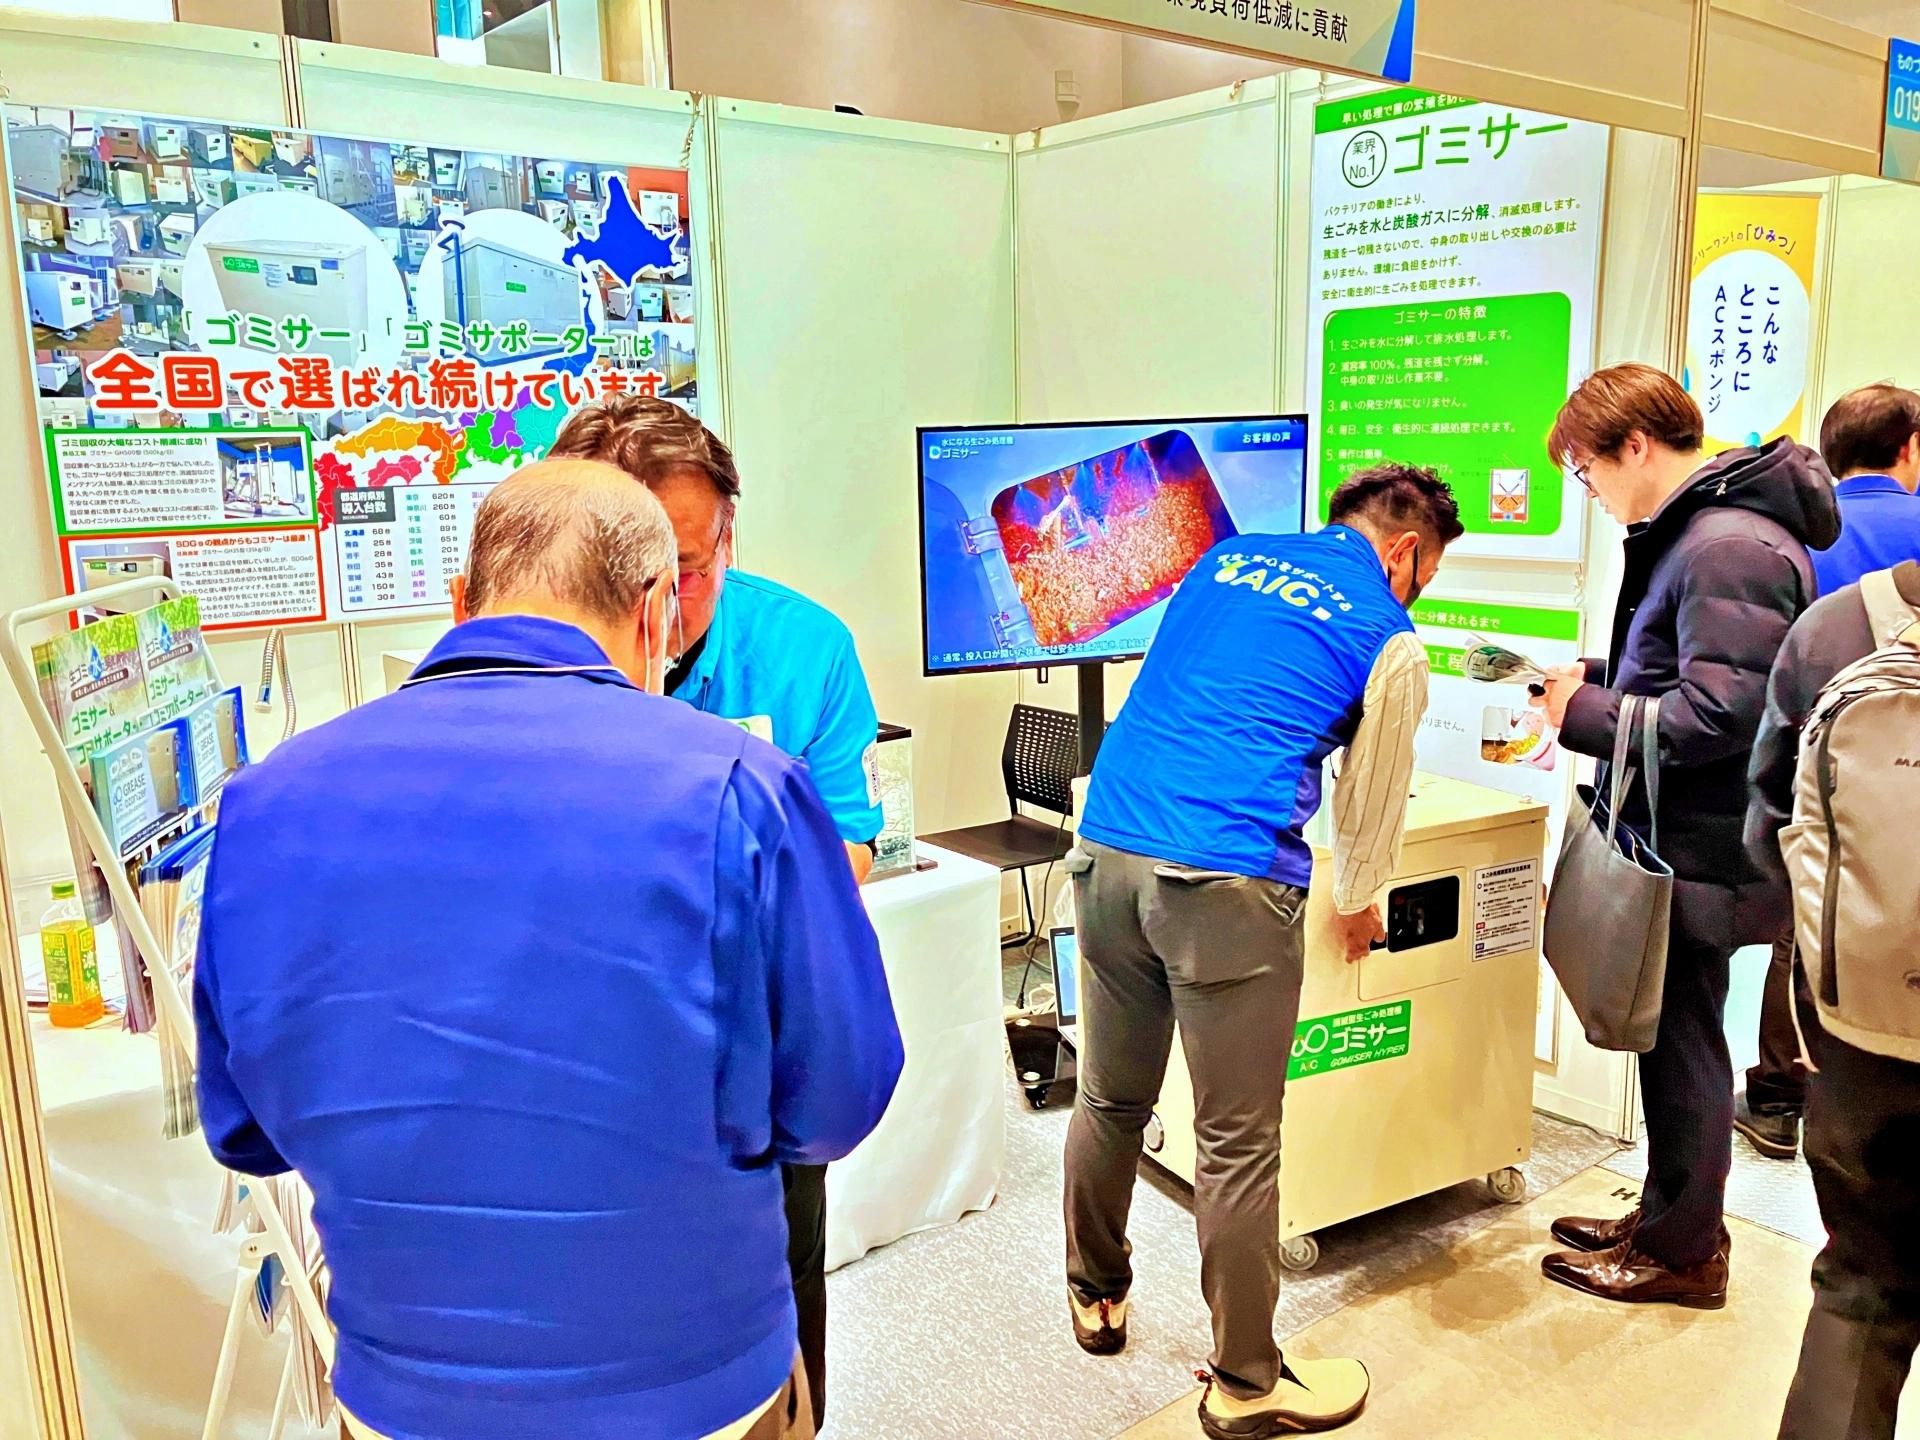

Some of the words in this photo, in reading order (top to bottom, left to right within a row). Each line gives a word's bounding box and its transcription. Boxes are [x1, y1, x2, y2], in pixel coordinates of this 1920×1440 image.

[1167, 0, 1348, 43] 負荷低減に貢献
[1894, 86, 1920, 123] 019
[1352, 138, 1376, 154] 業界
[1394, 113, 1568, 174] ゴミサー
[1350, 154, 1376, 179] No.1
[1323, 197, 1581, 239] 生ごみを水と炭酸ガスに分解、消滅処理します。
[1325, 194, 1426, 217] バクテリアの働きにより、
[1323, 255, 1462, 280] ありません。環境に負担をかけず、
[1393, 305, 1487, 325] ゴミサーの特徴
[1763, 286, 1780, 364] こんな
[1708, 285, 1727, 413] ACスポンジ
[1733, 284, 1755, 392] ところに
[1242, 431, 1291, 443] お客様の声
[942, 448, 979, 459] ゴミサー
[341, 501, 387, 514] 導入台数
[1230, 569, 1319, 607] AIC
[1331, 1022, 1407, 1054] ゴミサー
[1330, 1051, 1373, 1068] GOMISER
[1374, 1044, 1406, 1058] HYPER
